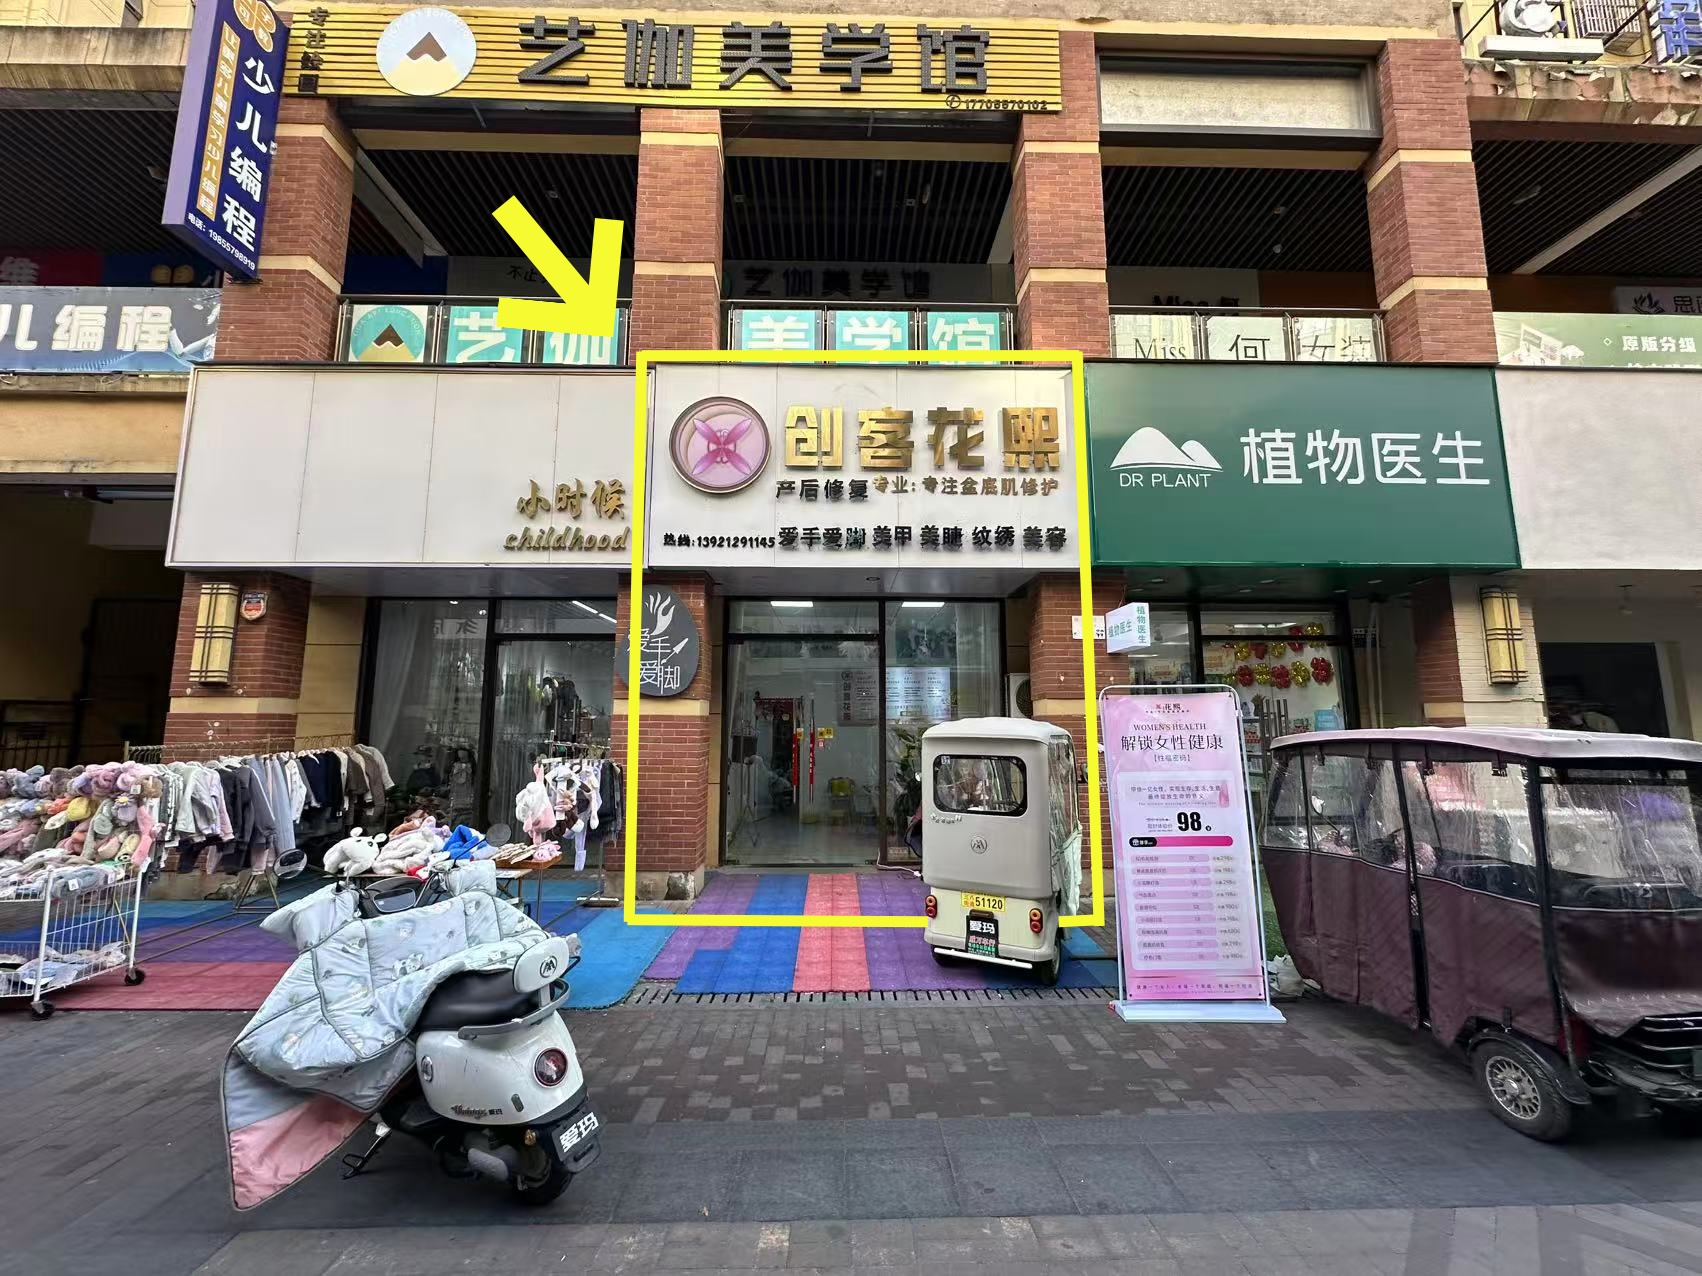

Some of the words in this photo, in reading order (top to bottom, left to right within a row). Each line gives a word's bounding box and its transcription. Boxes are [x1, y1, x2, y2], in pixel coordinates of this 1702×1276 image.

[517, 15, 991, 95] 艺伽美学馆
[221, 56, 275, 252] 少儿编程
[208, 229, 256, 270] 19855798919
[506, 265, 547, 284] 不止
[784, 406, 1060, 470] 创客花熙
[1239, 428, 1491, 486] 植物医生
[776, 479, 868, 501] 产后修复
[1119, 474, 1144, 488] DR
[1151, 473, 1212, 488] PLANT
[517, 478, 626, 520] 小时候
[504, 526, 631, 551] childhood
[778, 525, 867, 550] 爱手爱脚
[872, 525, 912, 549] 美甲
[920, 525, 963, 550] 美睫
[971, 525, 1016, 549] 纹绣
[1023, 525, 1068, 551] 美容
[1108, 619, 1133, 638] 植物医生
[1136, 606, 1147, 644] 植物医生
[1134, 723, 1171, 732] WOMEN'S
[1172, 722, 1207, 731] HEALTH
[1121, 734, 1224, 751] 解锁女性健康
[1177, 811, 1203, 837] 98
[975, 896, 1003, 910] 51120
[969, 920, 995, 934] 爱玛
[559, 1111, 599, 1153] 爱玛
